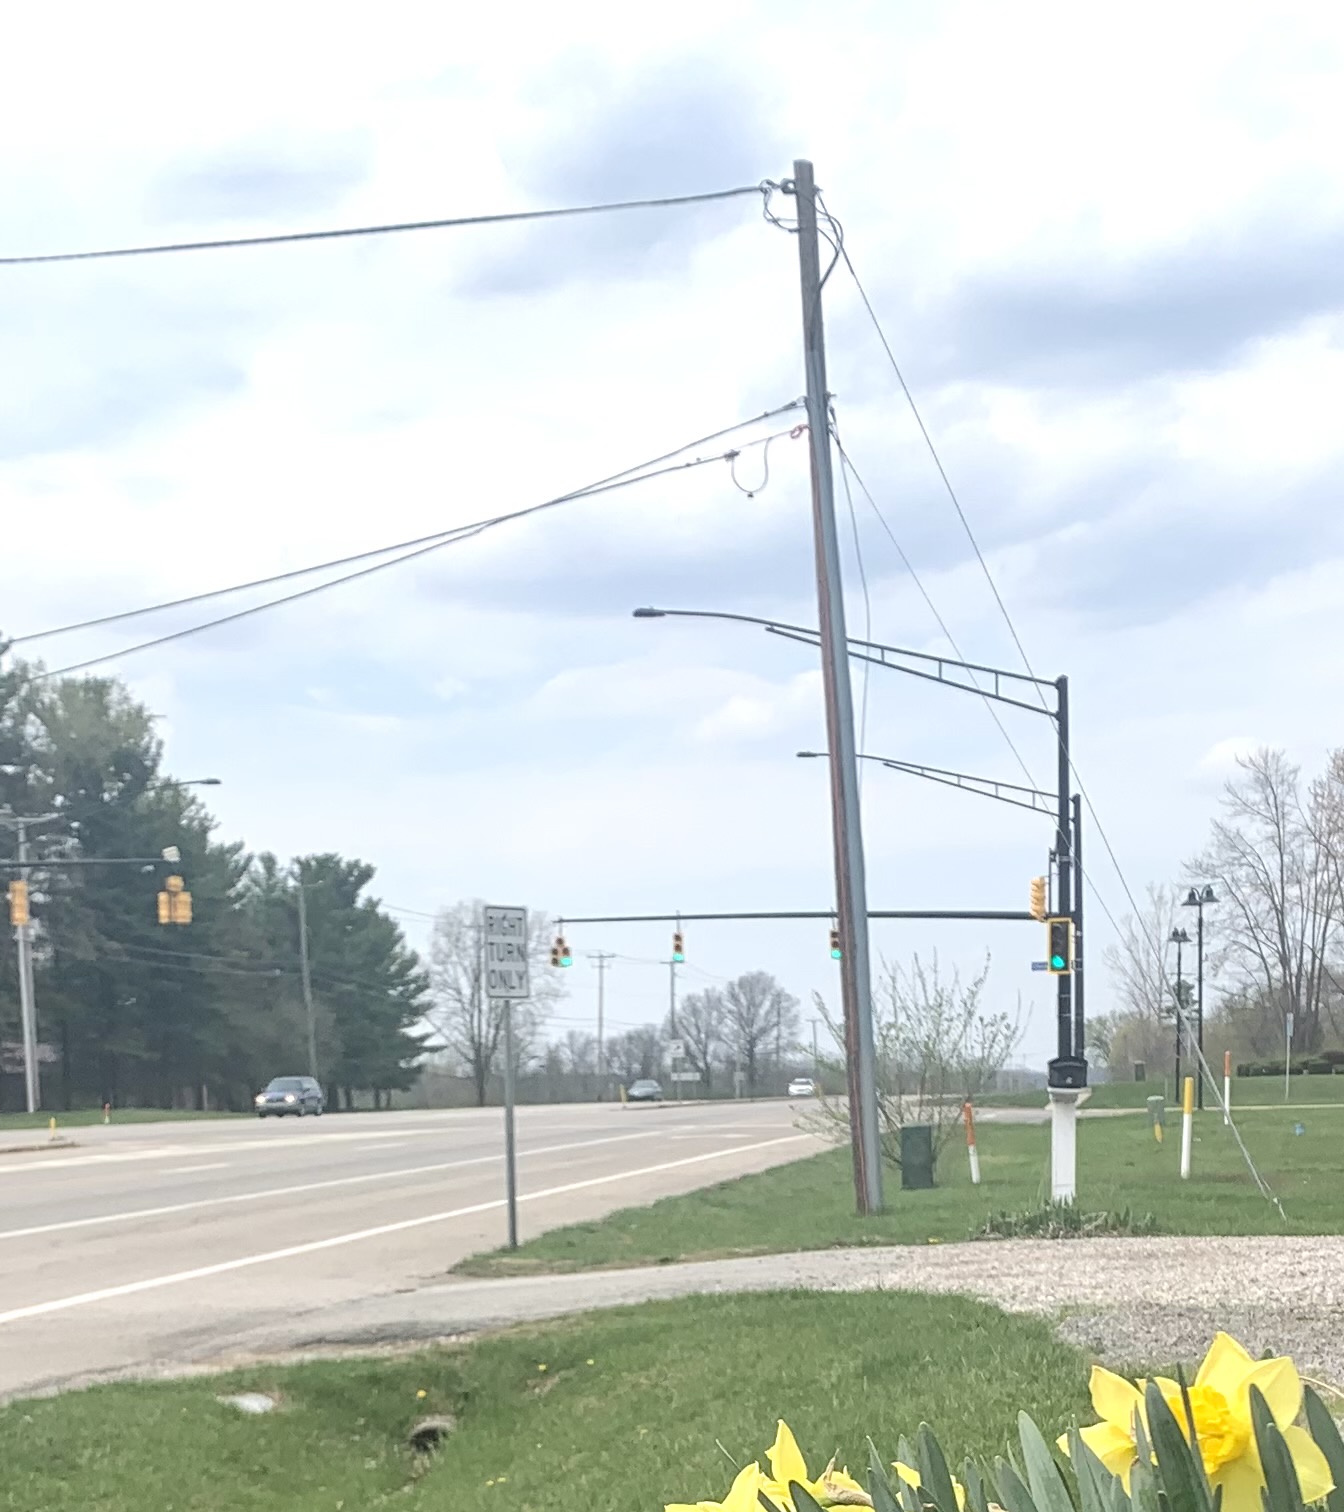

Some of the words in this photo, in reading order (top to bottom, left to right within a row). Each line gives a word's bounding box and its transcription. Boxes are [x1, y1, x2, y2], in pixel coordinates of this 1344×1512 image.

[486, 915, 524, 936] RIGHT
[487, 942, 525, 961] TURN
[488, 968, 526, 990] ONLY
